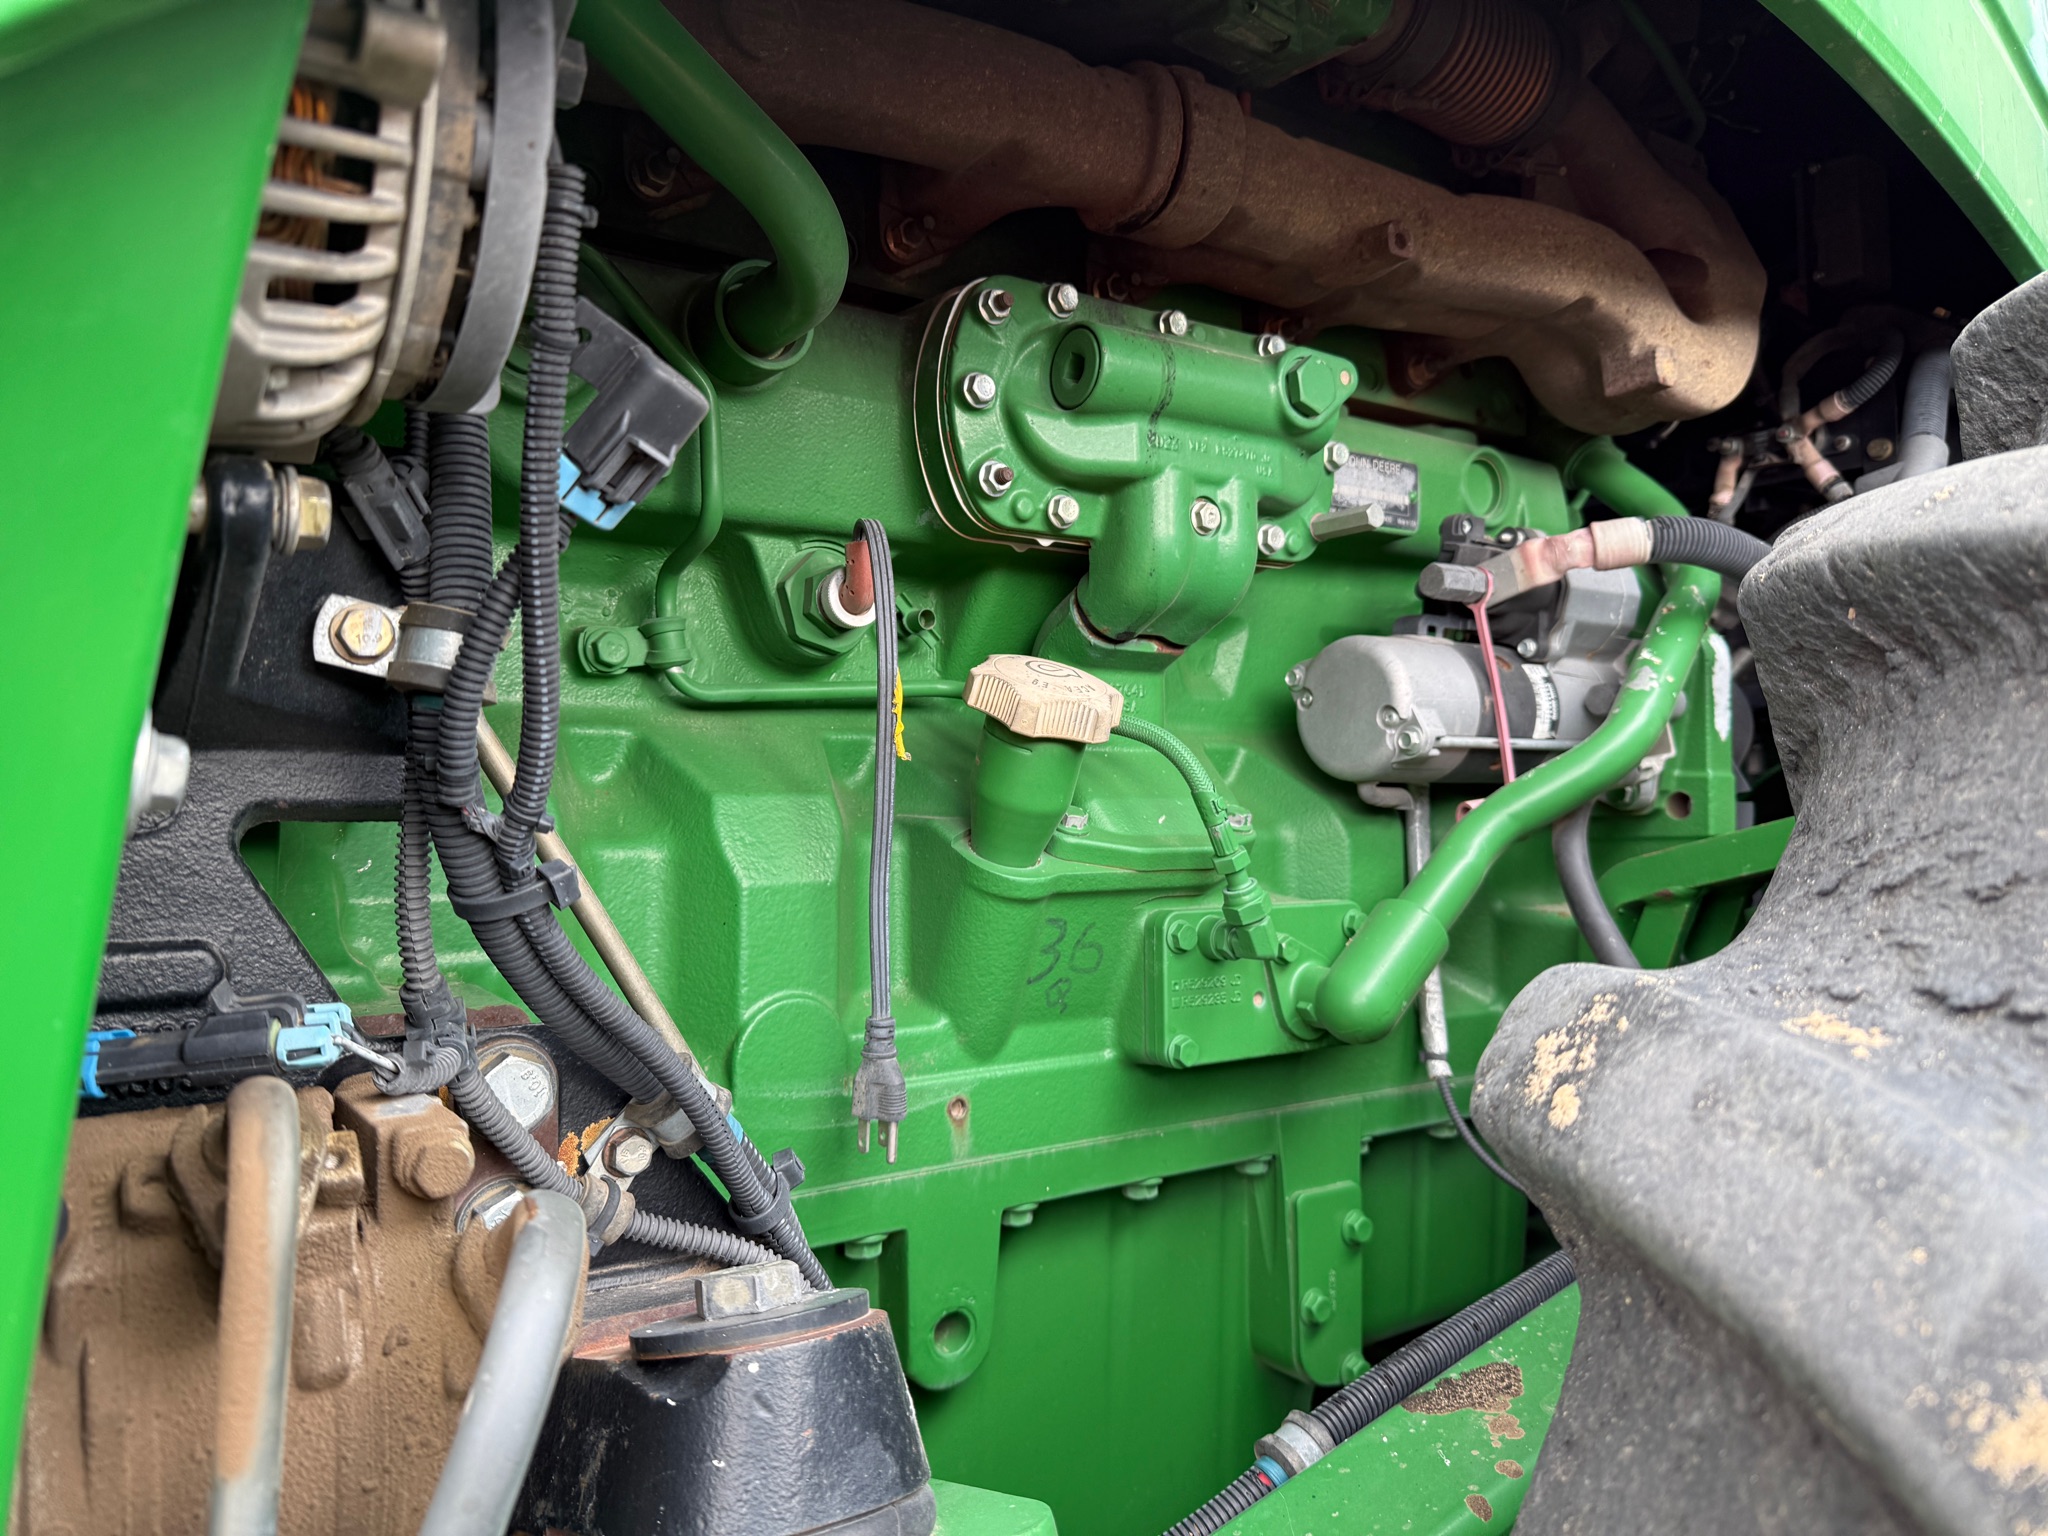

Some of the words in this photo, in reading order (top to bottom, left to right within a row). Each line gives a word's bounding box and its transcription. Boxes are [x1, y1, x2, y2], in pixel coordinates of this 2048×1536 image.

[1347, 455, 1372, 468] OHN
[1372, 460, 1402, 475] DEERE
[1026, 917, 1104, 985] 36
